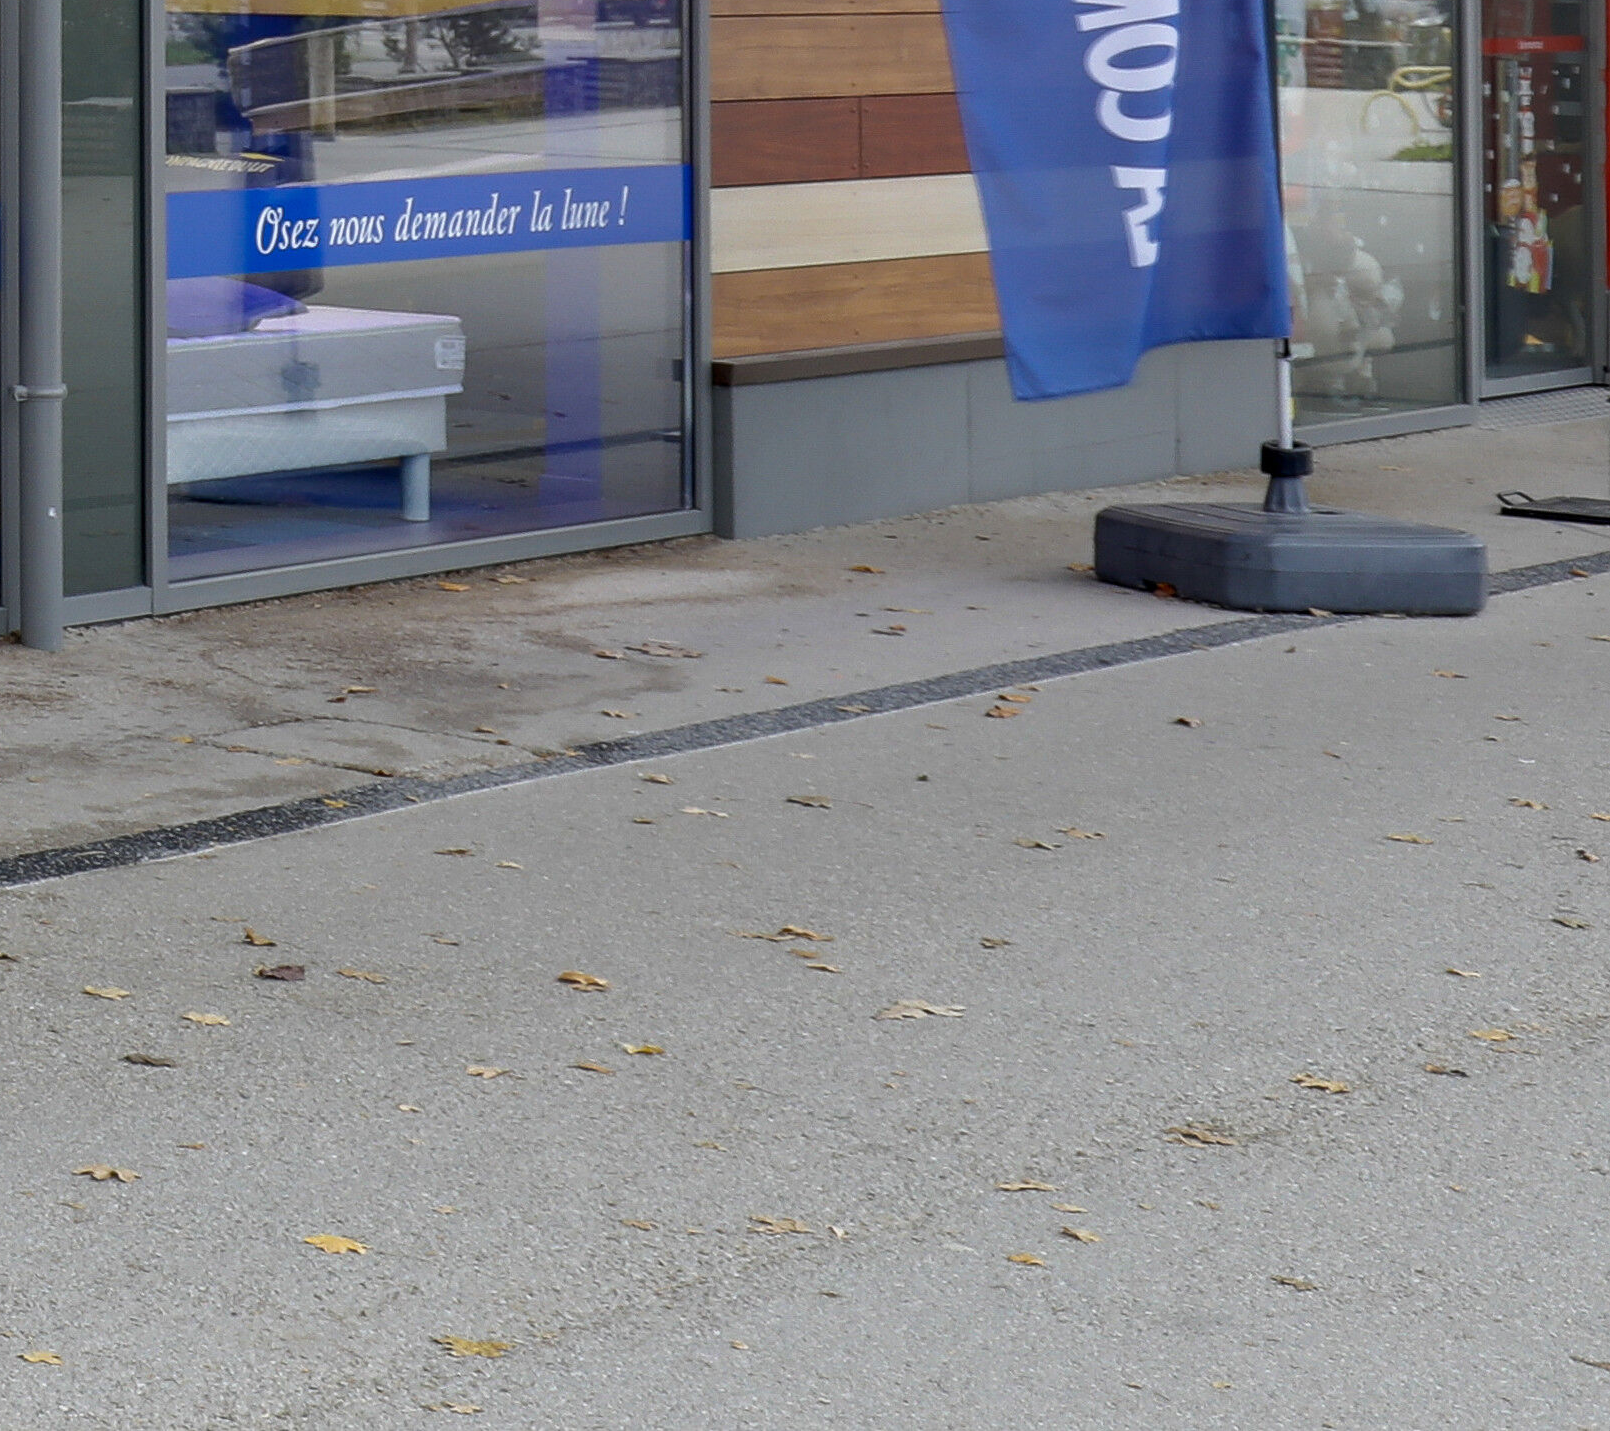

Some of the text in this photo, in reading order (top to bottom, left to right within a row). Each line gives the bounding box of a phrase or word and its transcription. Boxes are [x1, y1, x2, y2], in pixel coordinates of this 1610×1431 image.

[256, 185, 630, 255] Osez nous demander la lune !
